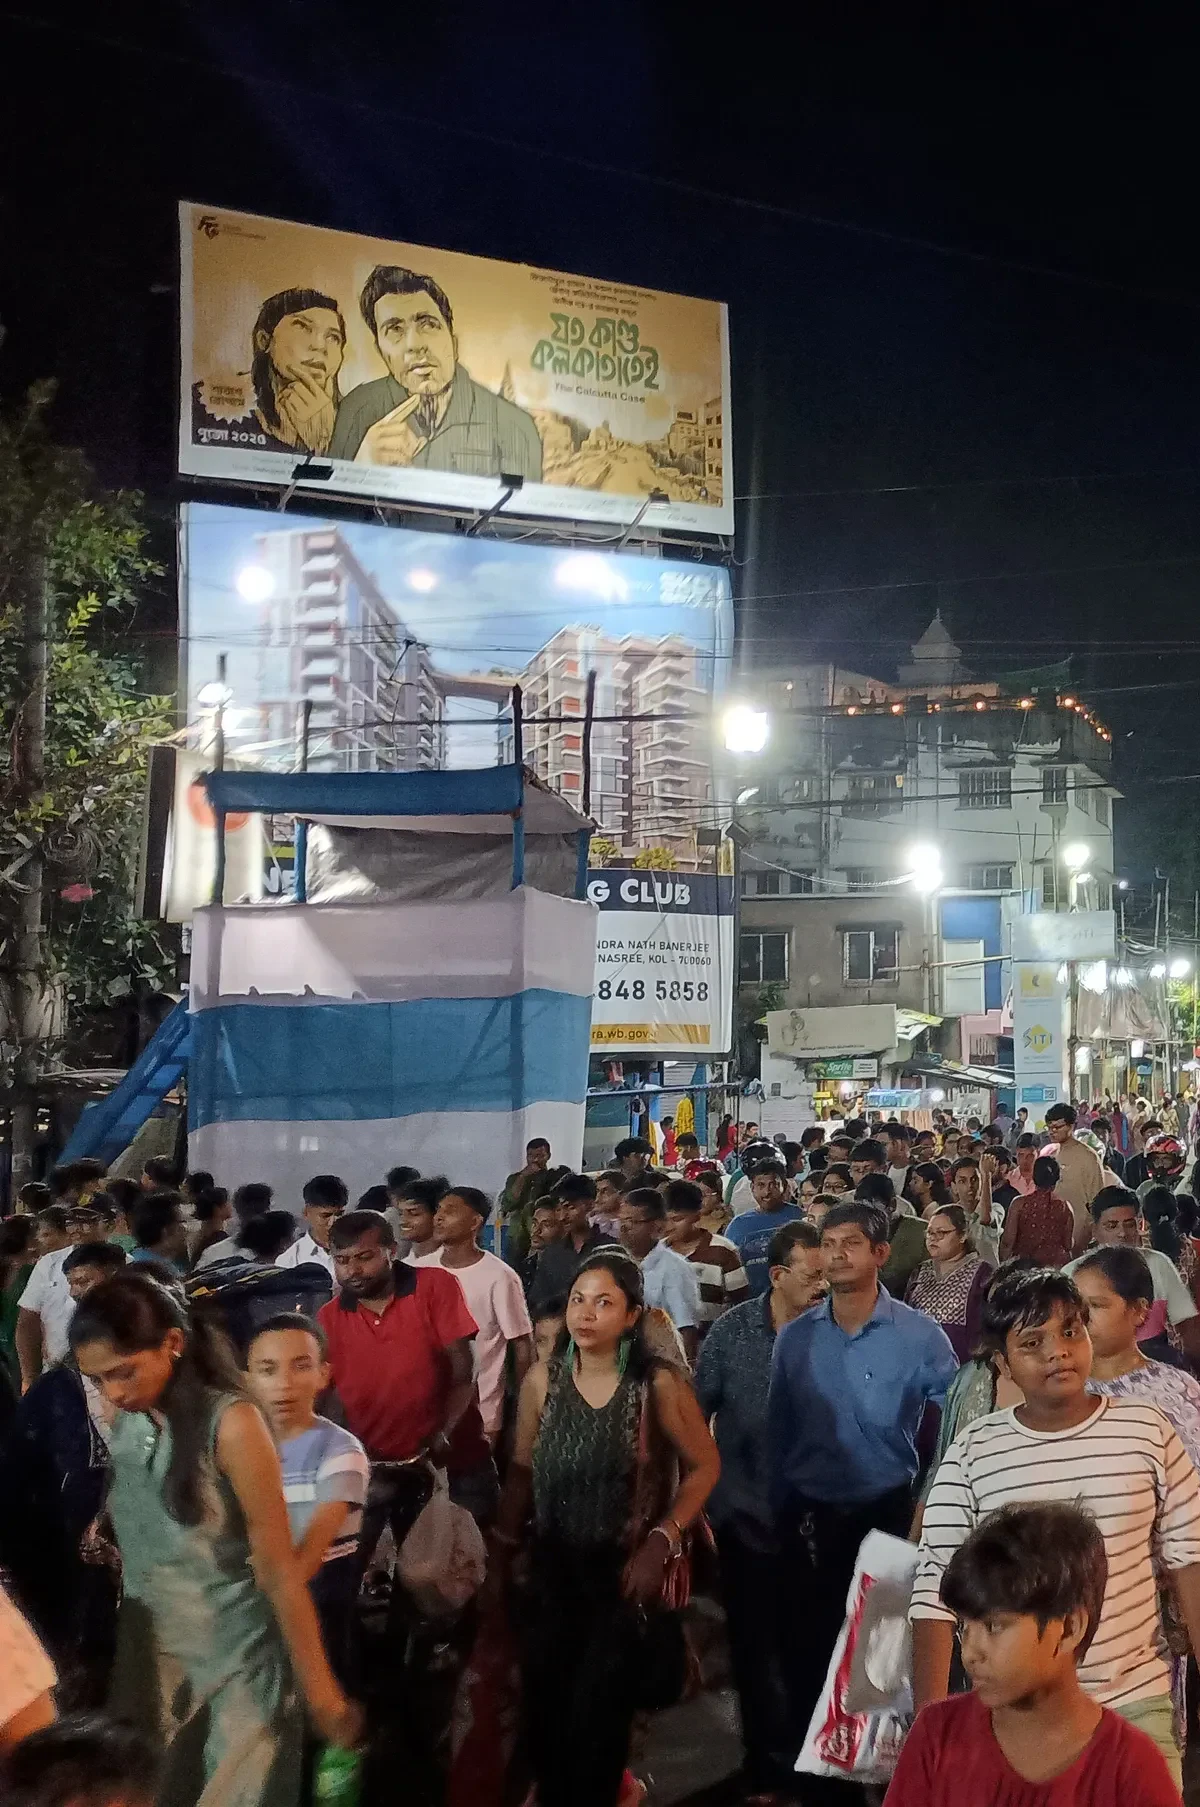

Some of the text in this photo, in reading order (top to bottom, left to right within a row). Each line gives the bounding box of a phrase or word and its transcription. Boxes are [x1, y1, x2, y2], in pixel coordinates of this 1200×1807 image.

[550, 313, 585, 346] যত
[530, 338, 660, 391] কলকাতাতেই
[575, 385, 618, 400] Calcutta
[620, 392, 646, 403] Case
[619, 878, 691, 905] CLUB
[628, 940, 656, 950] NATH
[660, 941, 710, 953] BANERJEE
[648, 955, 668, 964] KOL
[656, 981, 709, 1001] 5858
